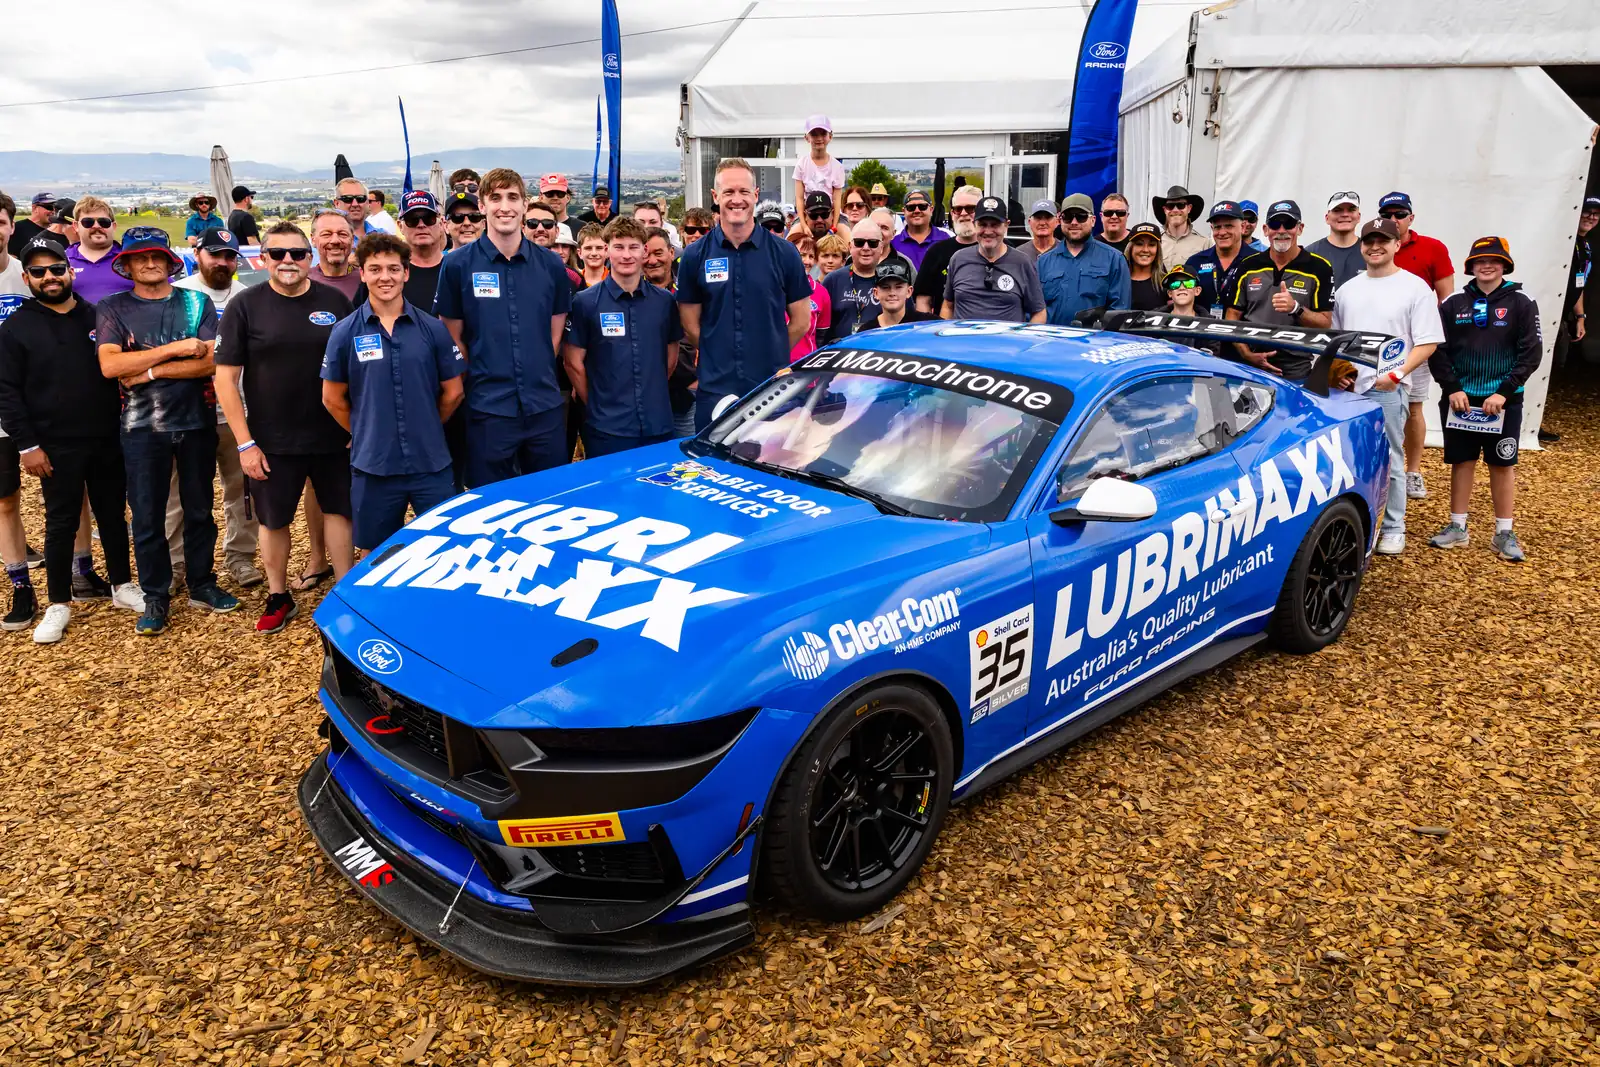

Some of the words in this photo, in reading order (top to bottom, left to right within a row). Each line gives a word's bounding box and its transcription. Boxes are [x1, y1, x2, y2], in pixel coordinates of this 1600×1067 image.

[1095, 44, 1118, 56] Ford
[1386, 342, 1402, 359] Ford
[832, 350, 1052, 410] Monochrome
[1379, 359, 1405, 375] RACING
[1447, 422, 1500, 433] RACING
[1461, 410, 1490, 423] Ford
[671, 481, 779, 519] SERVICES
[705, 474, 767, 493] ABLE
[757, 488, 832, 518] DOOR
[401, 493, 744, 573] LUBRI
[1046, 427, 1355, 671] LUBRIMAXX
[895, 643, 906, 655] AN
[907, 635, 925, 650] HME
[925, 620, 961, 642] COMPANY
[994, 621, 1011, 637] Shell
[1013, 612, 1030, 628] Card
[1045, 629, 1138, 706] Australia's
[1142, 591, 1201, 641] Quality
[1202, 543, 1274, 603] Lubricant
[362, 643, 395, 669] Ford
[975, 628, 1029, 702] 35
[1084, 656, 1143, 701] FORD
[1145, 607, 1216, 660] RACING
[992, 682, 1029, 708] SILVER
[508, 820, 615, 843] PIRELLI
